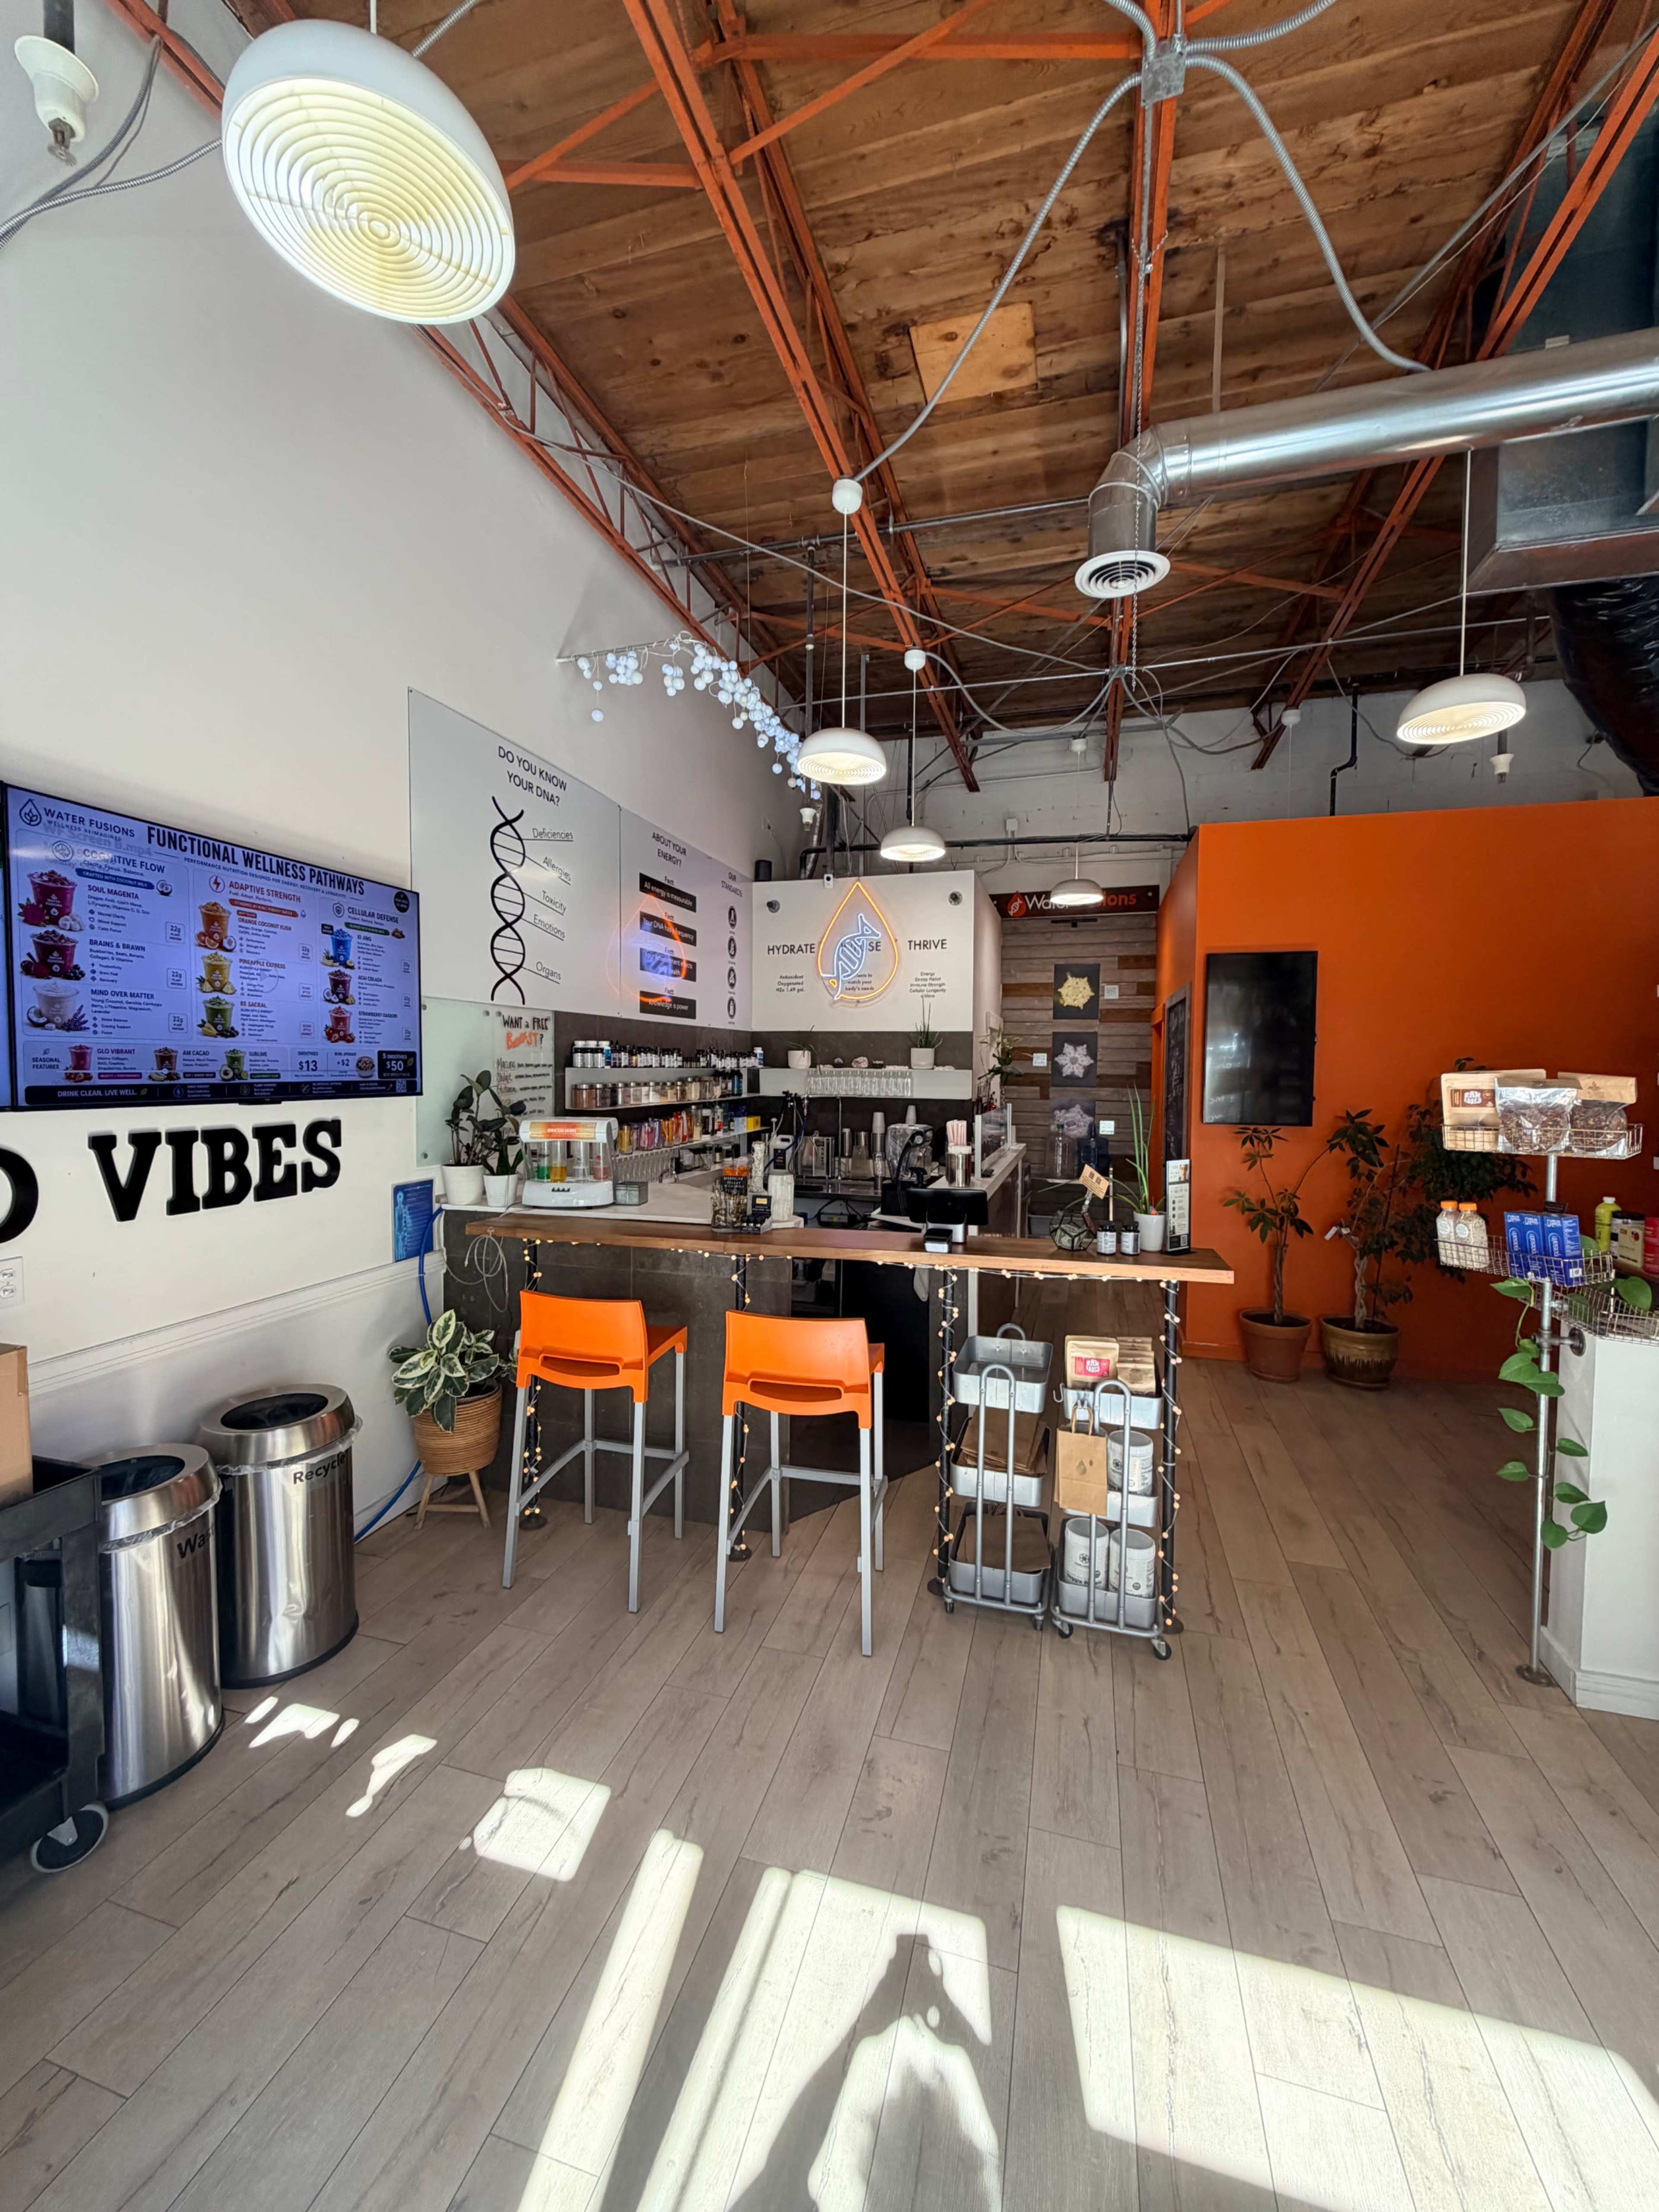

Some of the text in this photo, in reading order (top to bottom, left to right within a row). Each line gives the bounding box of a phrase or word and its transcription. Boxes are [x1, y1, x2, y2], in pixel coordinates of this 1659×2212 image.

[498, 745, 567, 792] DO YOU KNOW
[507, 770, 560, 806] YOUR DNA?
[44, 808, 135, 837] WATER FUSIONS
[47, 820, 122, 841] WELLNESS REIMAGINED
[532, 828, 574, 840] Deficiencies
[652, 832, 686, 856] ABOUT YOUR
[147, 825, 365, 895] FUNCTIONAL WELLNESS PATHWAYS
[658, 848, 682, 867] ENERGY?
[140, 861, 165, 873] FLOW
[543, 856, 572, 882] Allergies
[184, 857, 221, 870] PERFORMANCE
[222, 866, 248, 876] NUTRITION
[249, 872, 271, 882] DESIGNED
[301, 884, 321, 893] RECOVERY
[326, 890, 346, 899] LONGEVITY
[664, 876, 675, 885] Fact:
[728, 872, 737, 882] OUR
[88, 885, 139, 900] SOUL MAGENTA
[229, 881, 301, 903] ADAPTIVE STRENGTH
[652, 885, 665, 897] energy
[671, 892, 692, 907] measurable
[542, 890, 567, 914] Toxicity
[347, 907, 399, 923] CELLULAR DEFENSE
[257, 921, 280, 929] COCONUT
[533, 913, 566, 939] Emotions
[653, 921, 664, 929] DNA
[89, 939, 114, 948] BRAINS
[122, 943, 146, 952] BRAWN
[767, 943, 816, 955] HYDRATE
[908, 939, 947, 951] THRIVE
[239, 958, 265, 967] PINEAPPLE
[536, 961, 562, 980] Organs
[648, 1000, 672, 1009] Knowledge
[502, 1015, 523, 1029] WANT
[532, 1017, 549, 1031] FREE
[299, 1060, 318, 1072] $13
[386, 1060, 404, 1071] $50
[88, 1119, 341, 1222] VIBES
